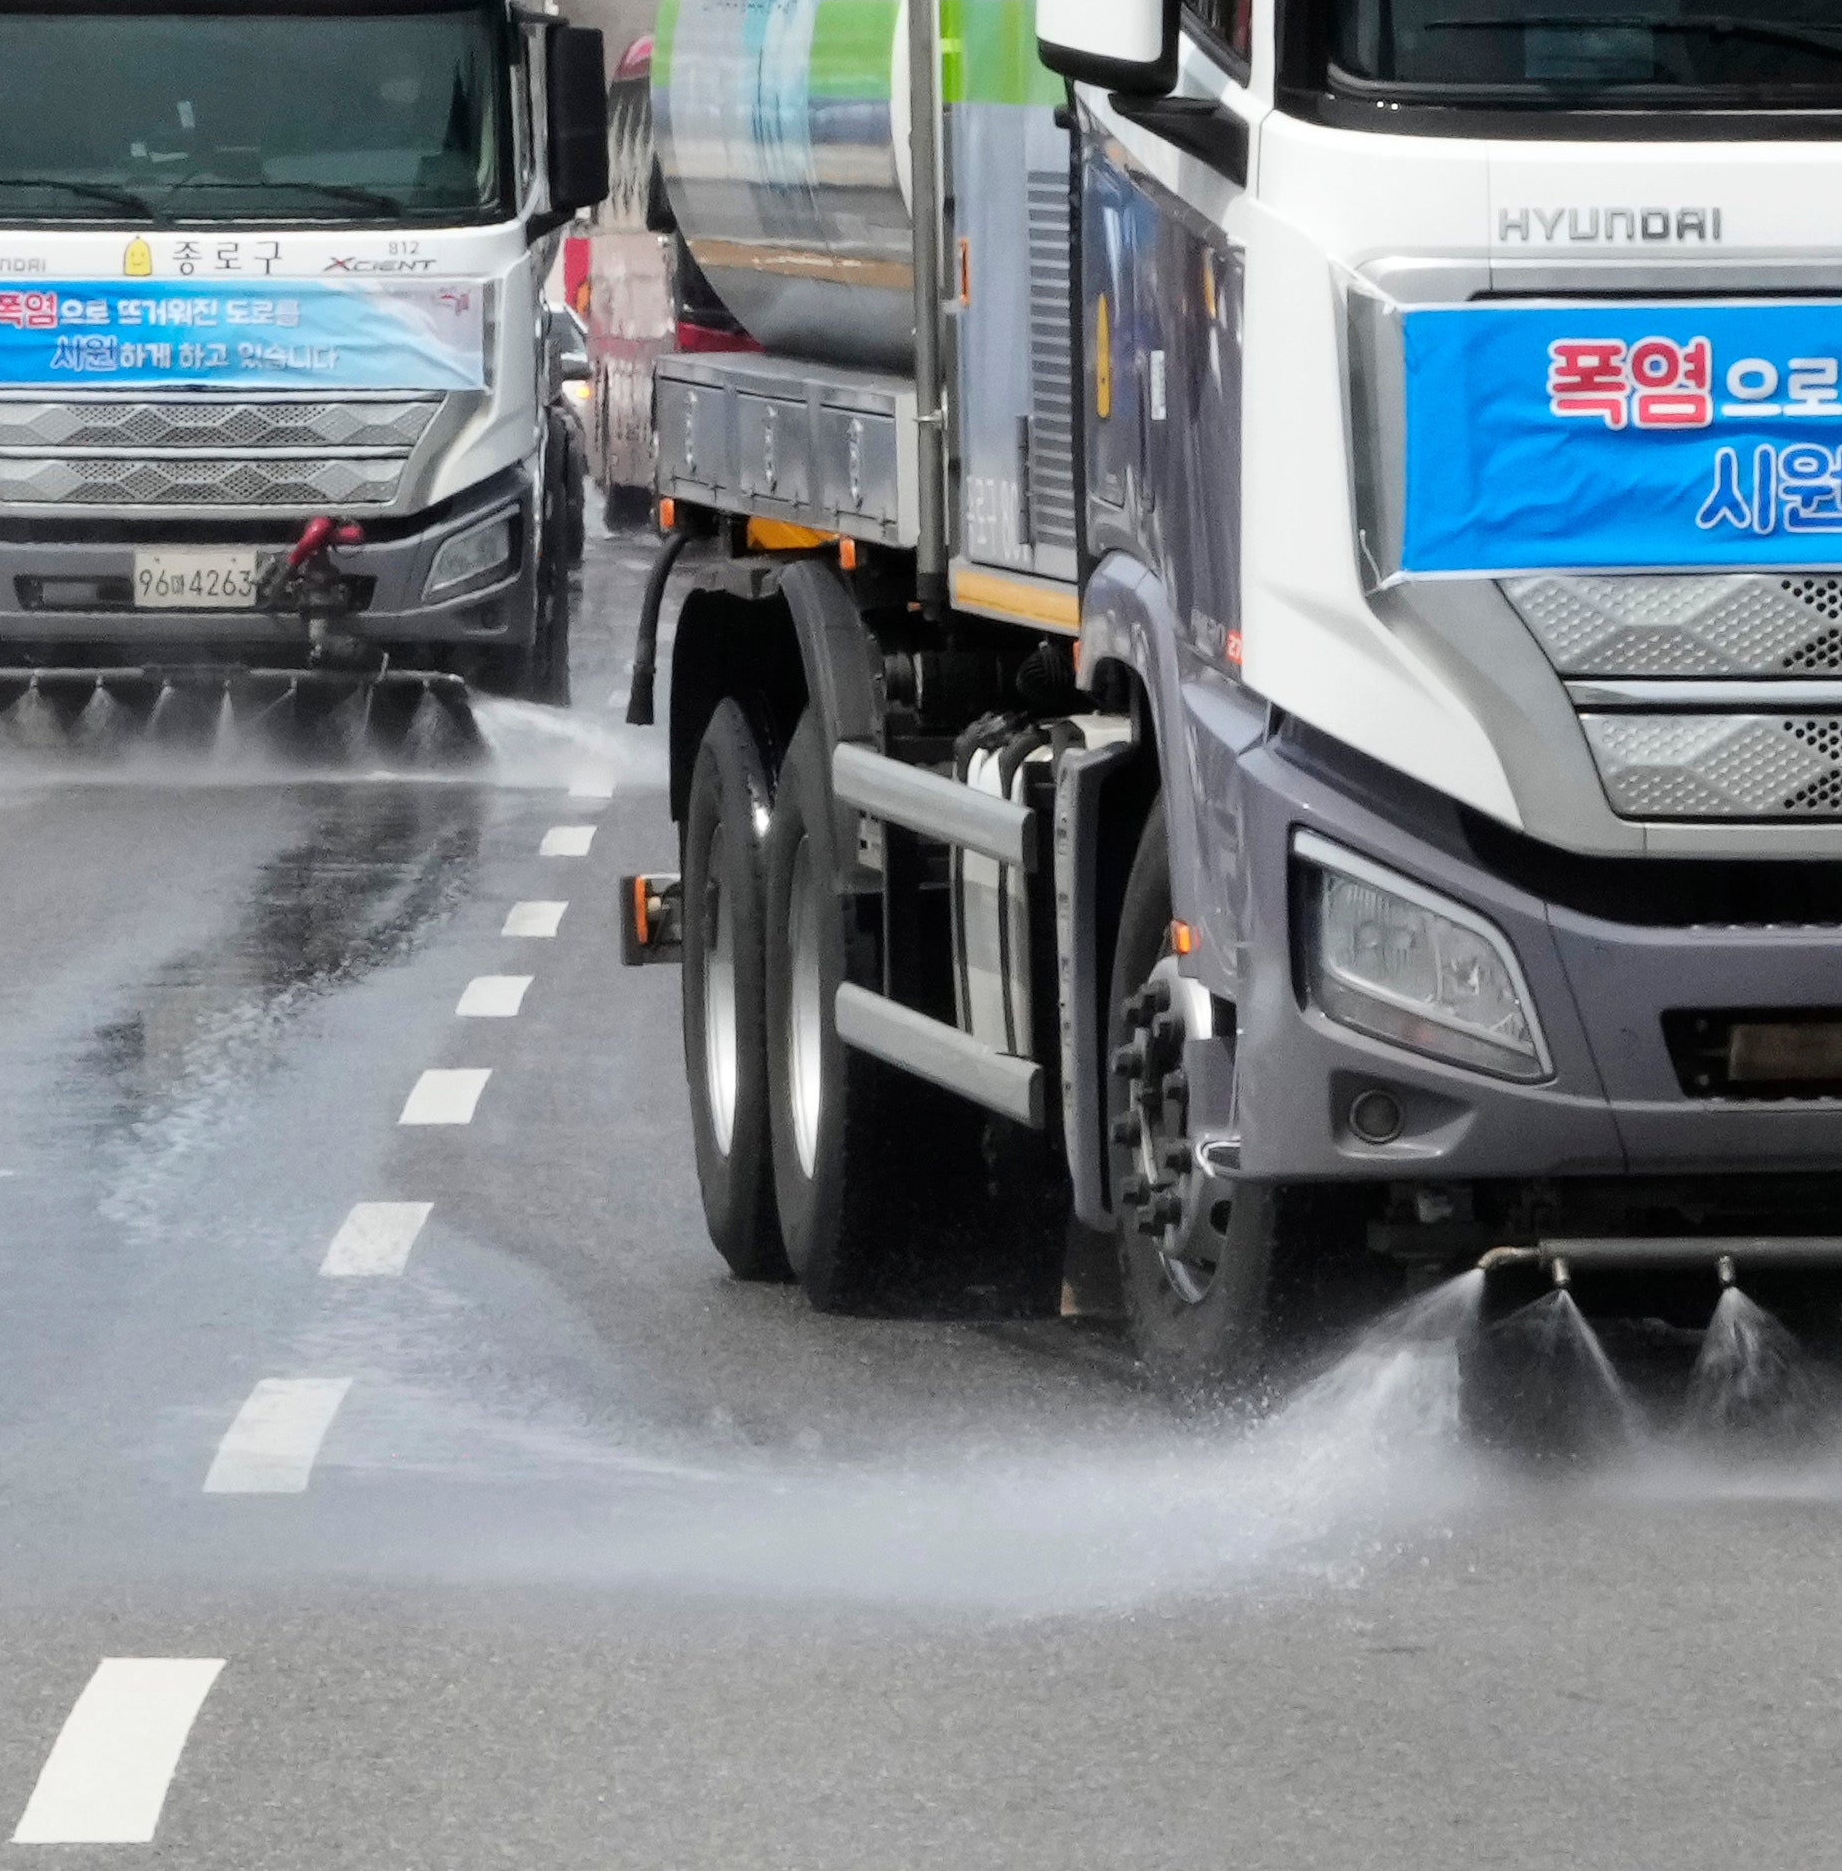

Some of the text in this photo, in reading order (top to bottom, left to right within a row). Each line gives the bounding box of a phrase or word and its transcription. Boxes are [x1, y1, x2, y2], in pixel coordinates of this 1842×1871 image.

[1498, 207, 1721, 242] HYUNDAI
[172, 241, 283, 276] 종로구
[323, 256, 438, 273] XCIENT
[388, 241, 420, 256] 812
[117, 298, 219, 327] 뜨거워진
[225, 298, 300, 327] 도로를
[50, 334, 340, 372] 시원하게 하고 있습니다
